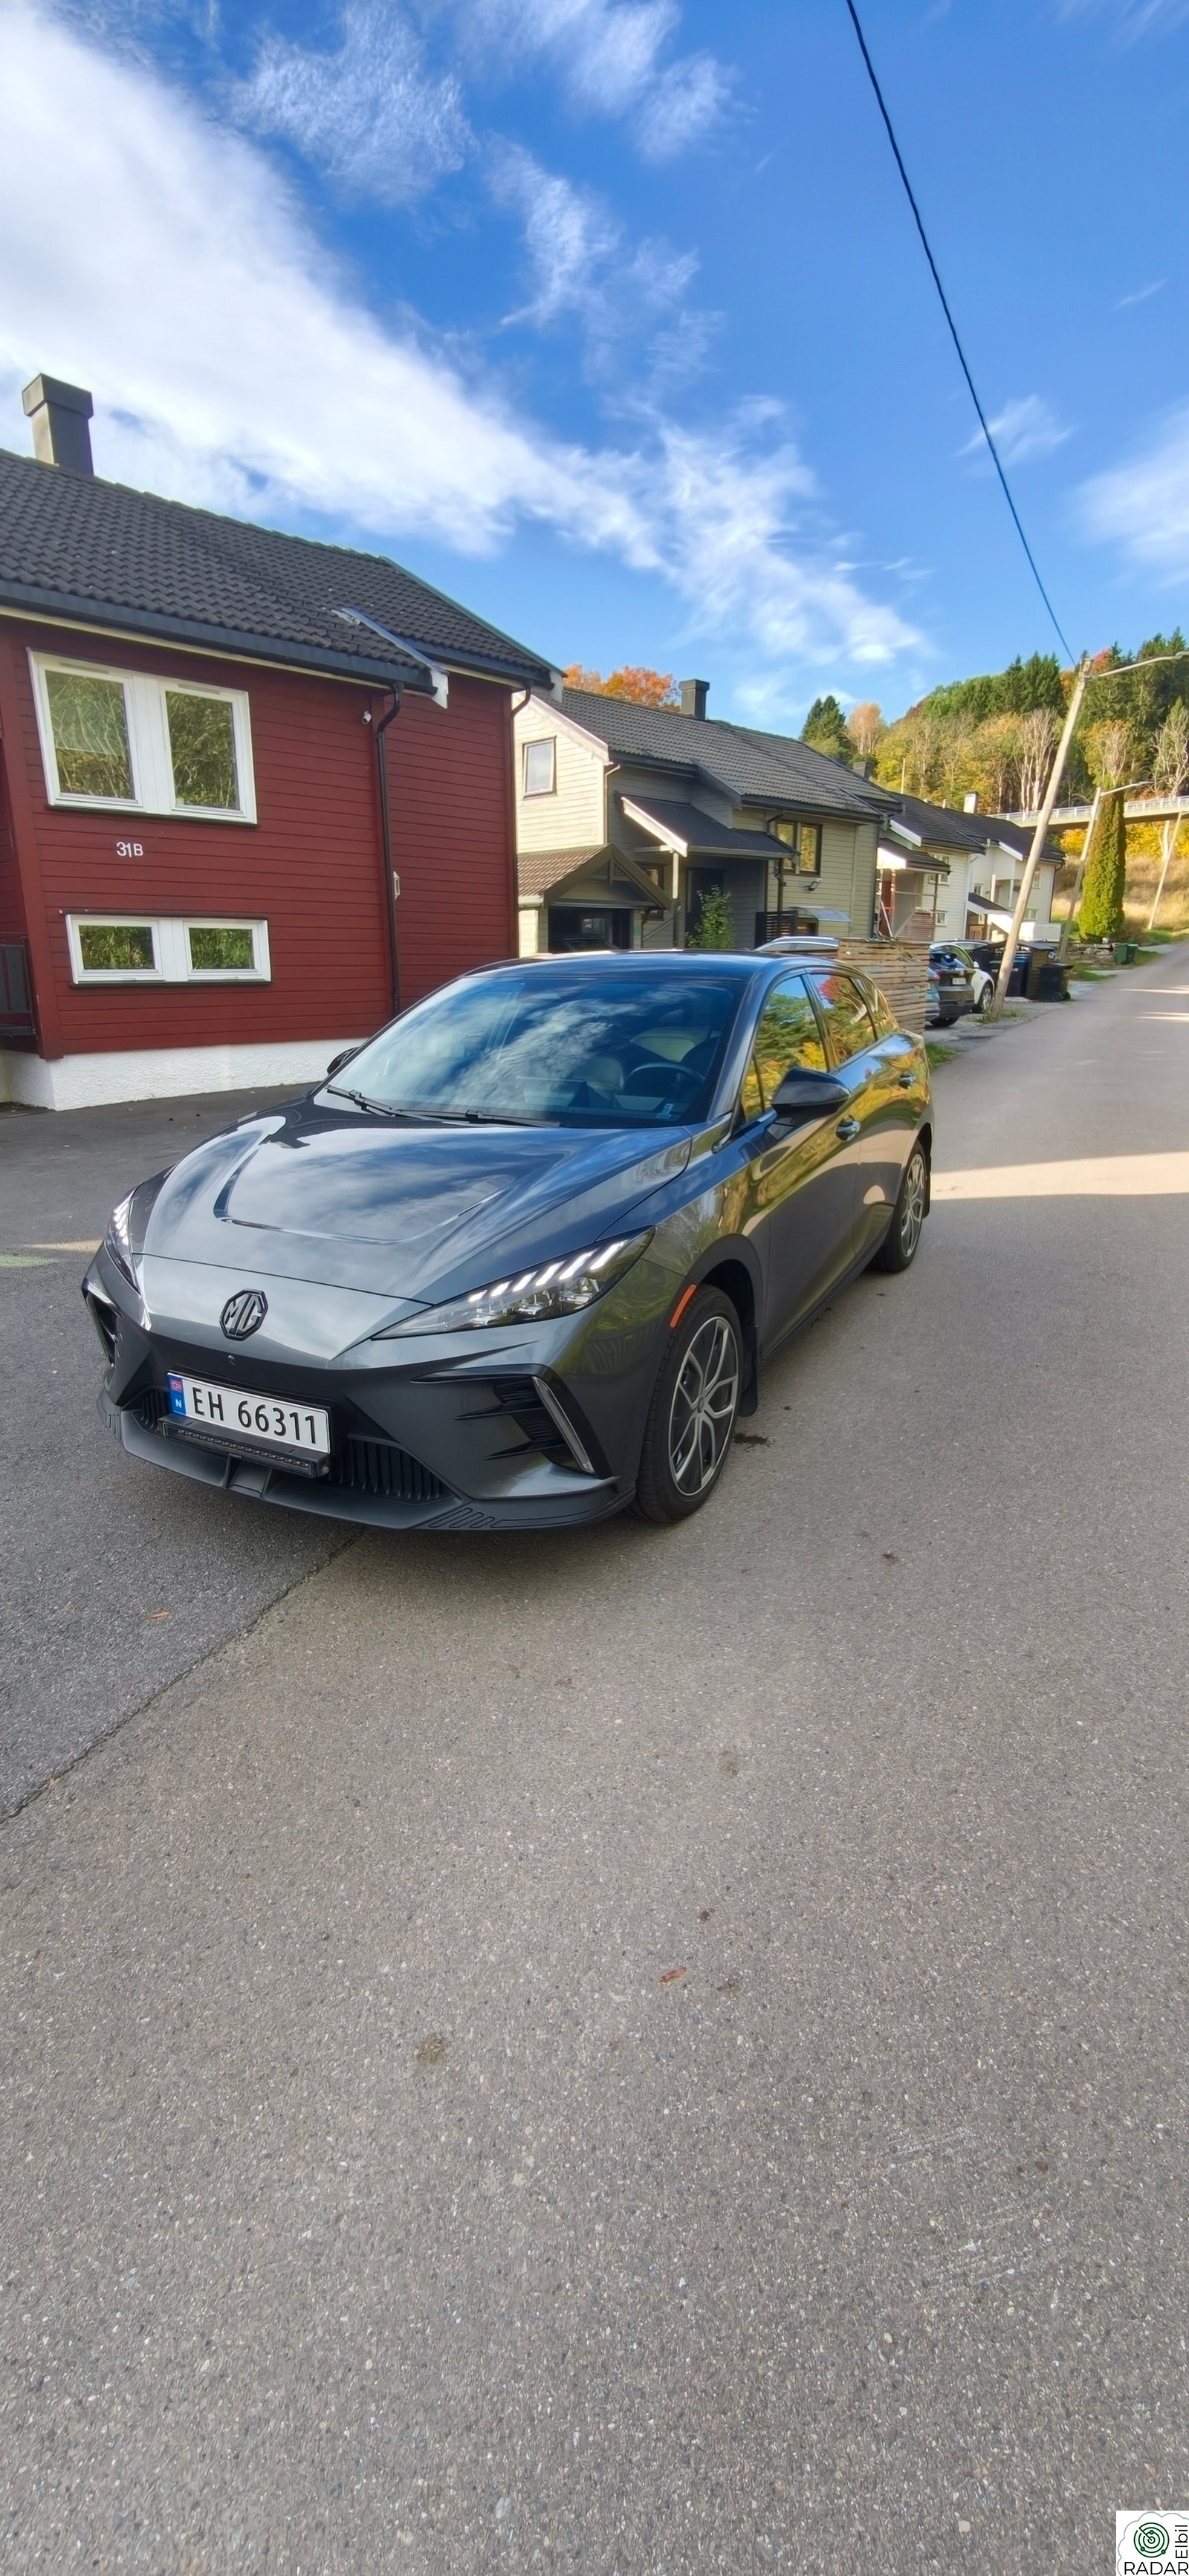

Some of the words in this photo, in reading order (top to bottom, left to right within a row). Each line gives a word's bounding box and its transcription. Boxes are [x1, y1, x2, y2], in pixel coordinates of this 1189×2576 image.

[116, 841, 143, 857] 31B
[223, 1293, 263, 1332] MG
[175, 1398, 182, 1408] N
[192, 1386, 224, 1421] EH
[238, 1401, 316, 1444] 66311
